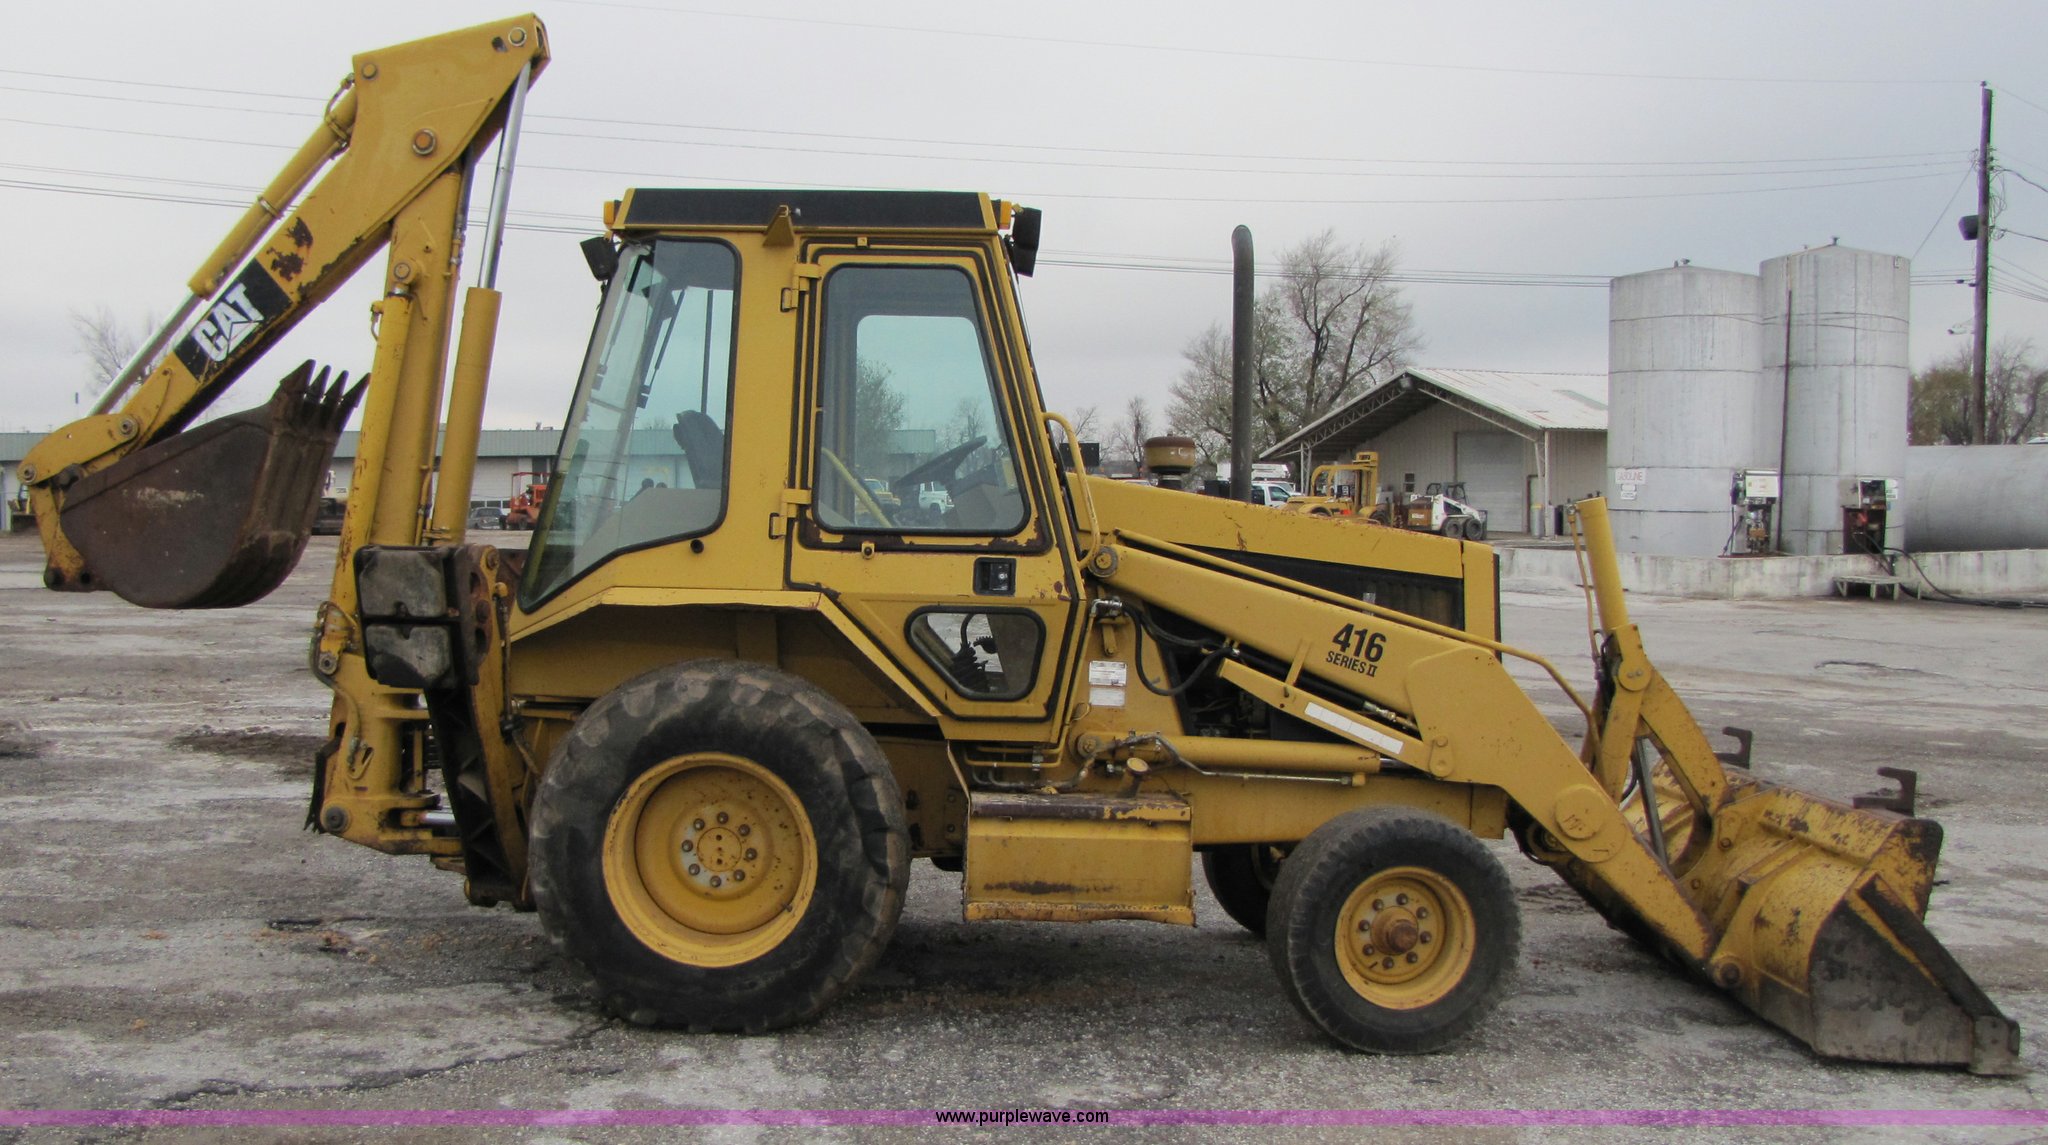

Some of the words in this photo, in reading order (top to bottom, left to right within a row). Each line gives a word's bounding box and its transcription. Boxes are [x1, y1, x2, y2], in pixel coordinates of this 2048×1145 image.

[191, 282, 264, 361] CAT
[1326, 650, 1367, 674] SERIES
[1332, 623, 1387, 662] 416
